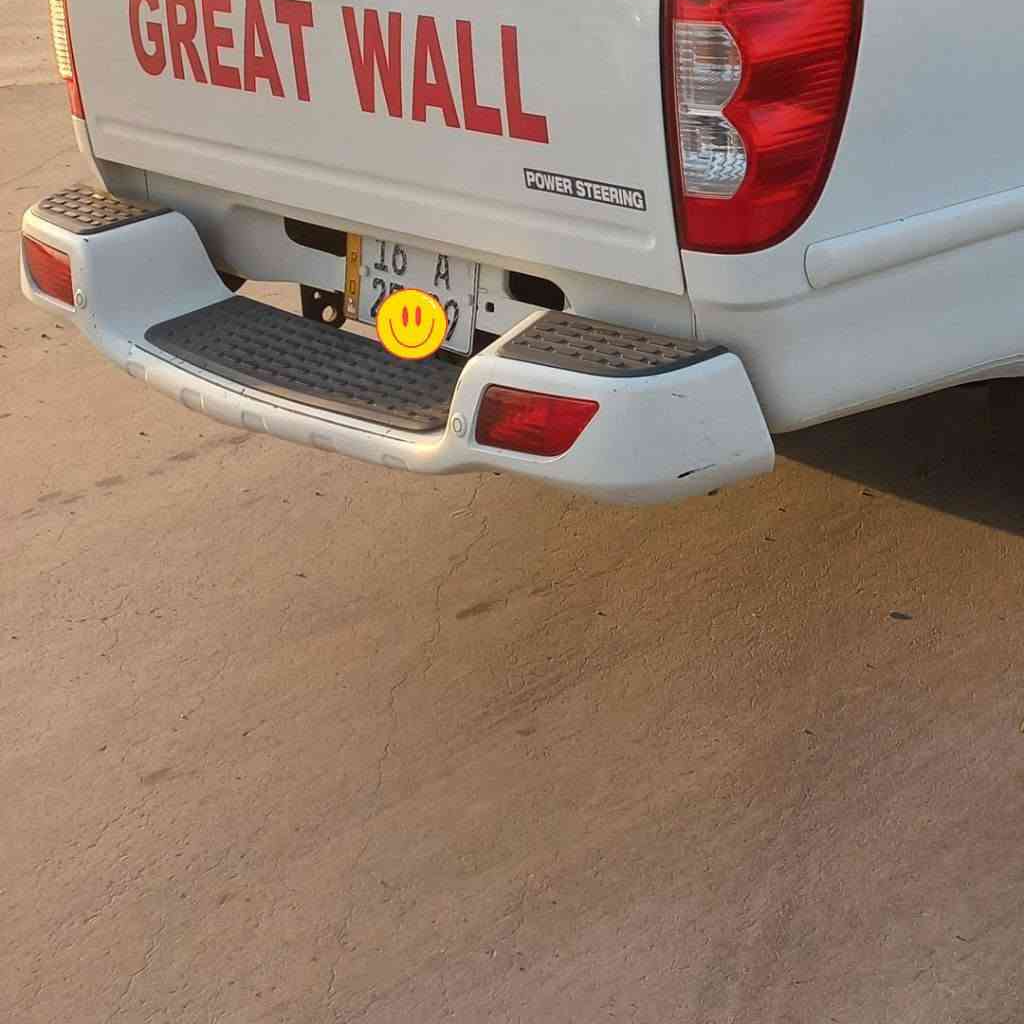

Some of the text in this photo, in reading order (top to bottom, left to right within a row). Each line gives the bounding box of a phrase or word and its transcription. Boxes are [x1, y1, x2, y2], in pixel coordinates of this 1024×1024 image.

[341, 6, 549, 144] WALL
[526, 171, 643, 208] POWER STEERING
